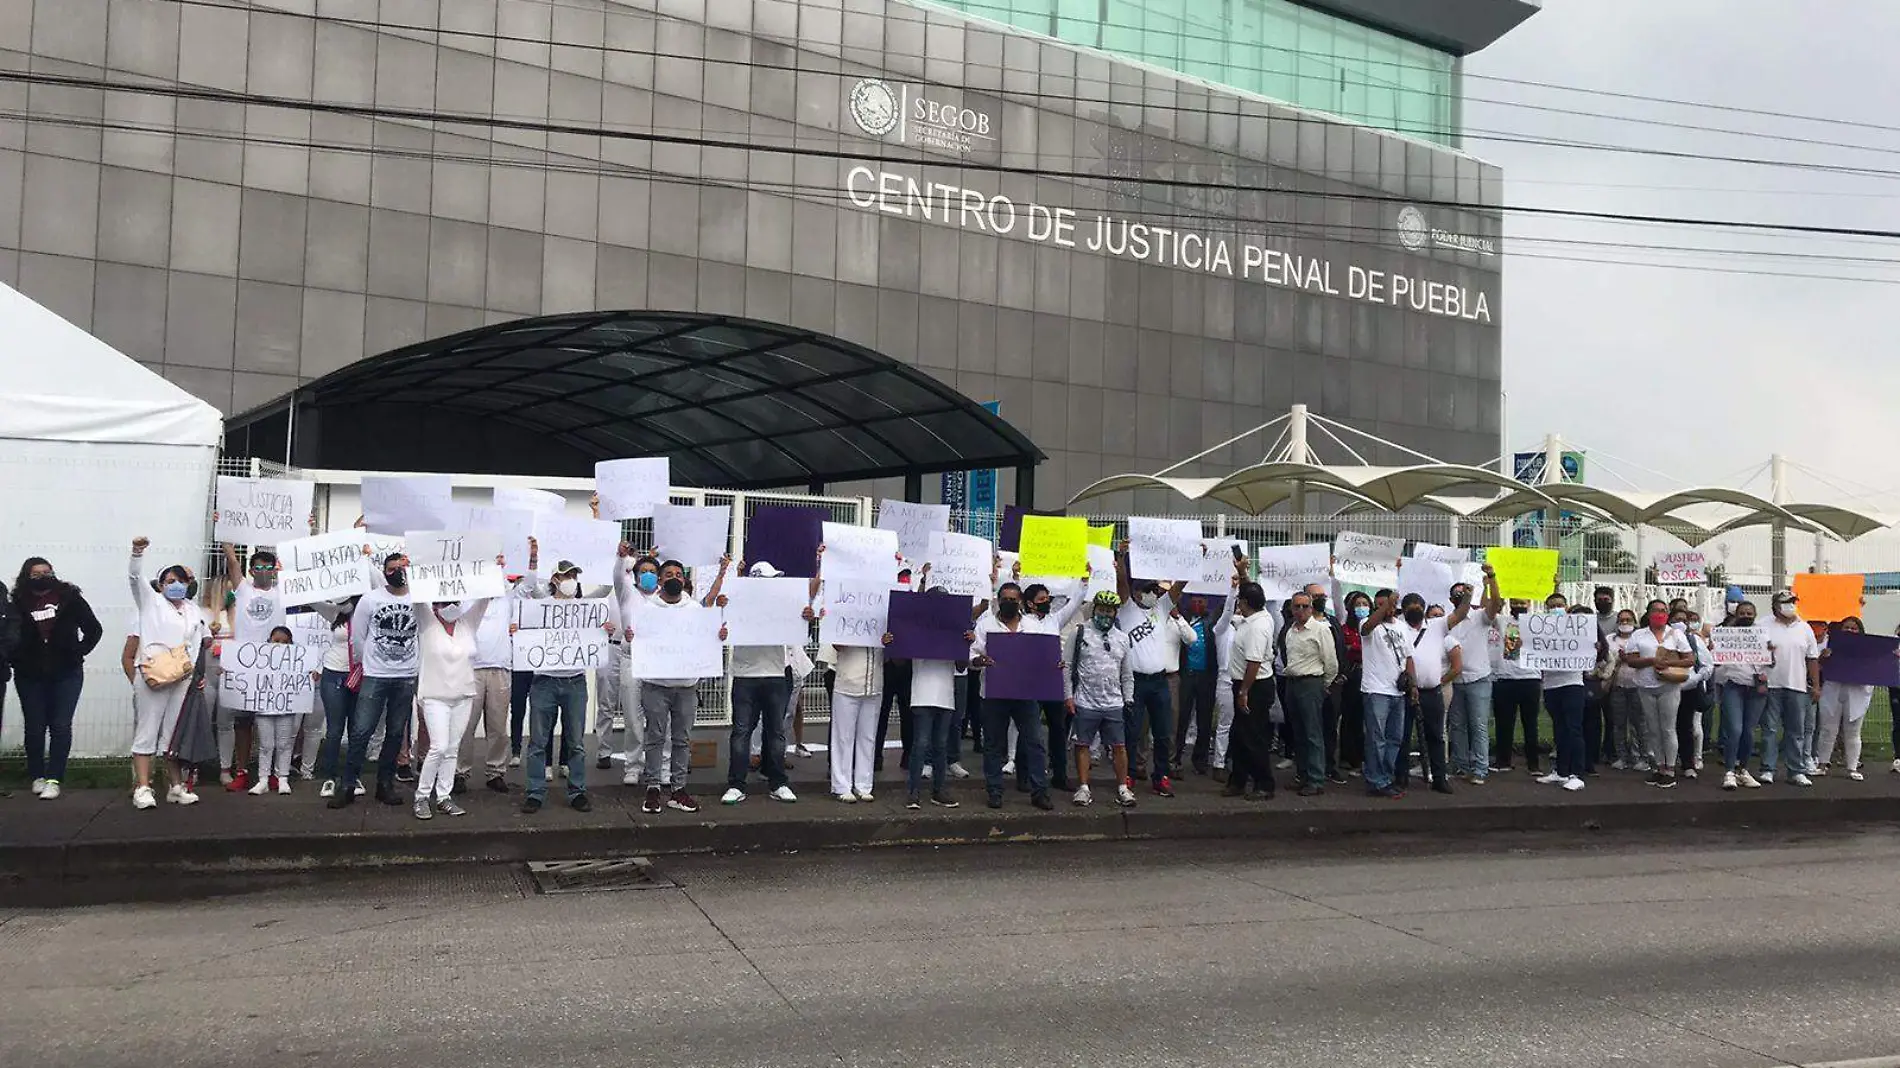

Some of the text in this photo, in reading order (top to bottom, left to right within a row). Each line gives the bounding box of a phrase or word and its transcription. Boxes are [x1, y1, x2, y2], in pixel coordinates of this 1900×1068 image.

[915, 97, 990, 134] SEGOB
[846, 166, 1491, 323] CENTRO DE JUSTICIA PENAL DE PUEBLA
[235, 481, 293, 515] JUSTICIA
[224, 509, 294, 530] PARA OSCAR
[294, 543, 362, 573] LIBERTAD
[436, 535, 465, 562] TÚ
[1659, 552, 1705, 565] JUSTICIA
[284, 566, 361, 595] PARA OSCAR
[1660, 568, 1701, 581] OSCAR
[438, 579, 468, 597] AMA
[518, 599, 610, 631] LIBERTAD
[835, 615, 879, 637] OSCAR
[1528, 613, 1590, 637] OSCAR
[544, 630, 583, 647] PARA
[1532, 636, 1580, 651] EVITO
[236, 641, 308, 673] OSCAR
[1526, 652, 1597, 669] FEMINICIDIO
[224, 669, 249, 692] ES
[255, 672, 274, 692] UN
